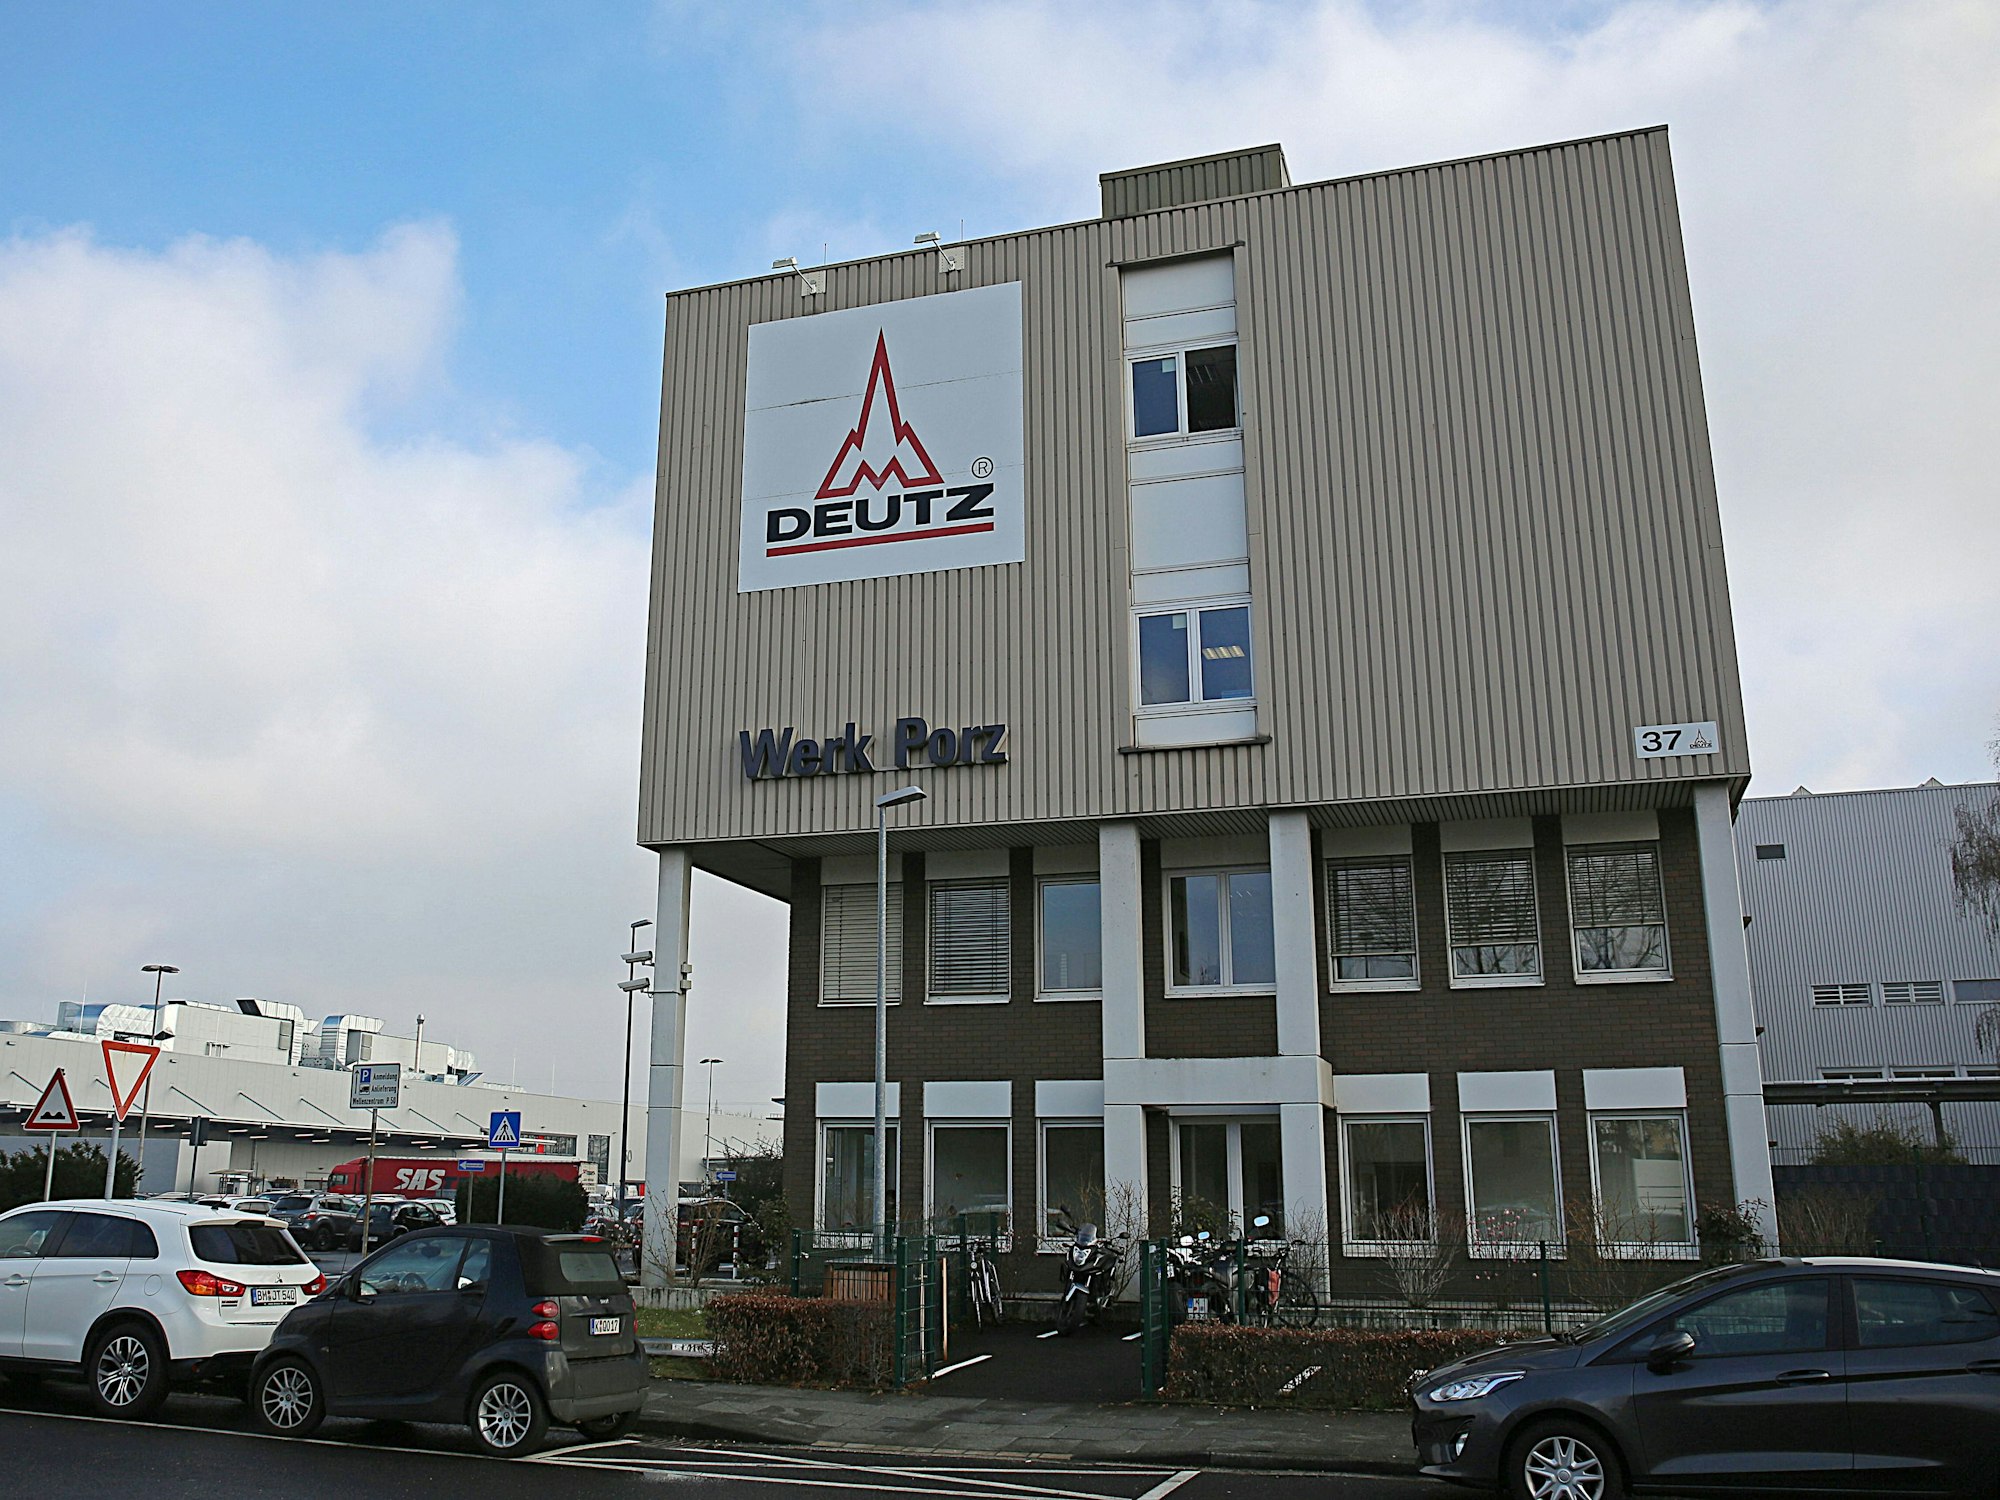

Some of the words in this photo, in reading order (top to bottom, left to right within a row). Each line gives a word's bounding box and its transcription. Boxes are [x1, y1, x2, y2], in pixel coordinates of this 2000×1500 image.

[766, 482, 994, 544] DEUTZ
[739, 722, 876, 780] Werk
[894, 716, 1009, 768] Porz
[1641, 729, 1682, 752] 37
[371, 1084, 397, 1093] Anlieferung
[373, 1073, 397, 1081] Anmeldung
[393, 1168, 446, 1191] SAS
